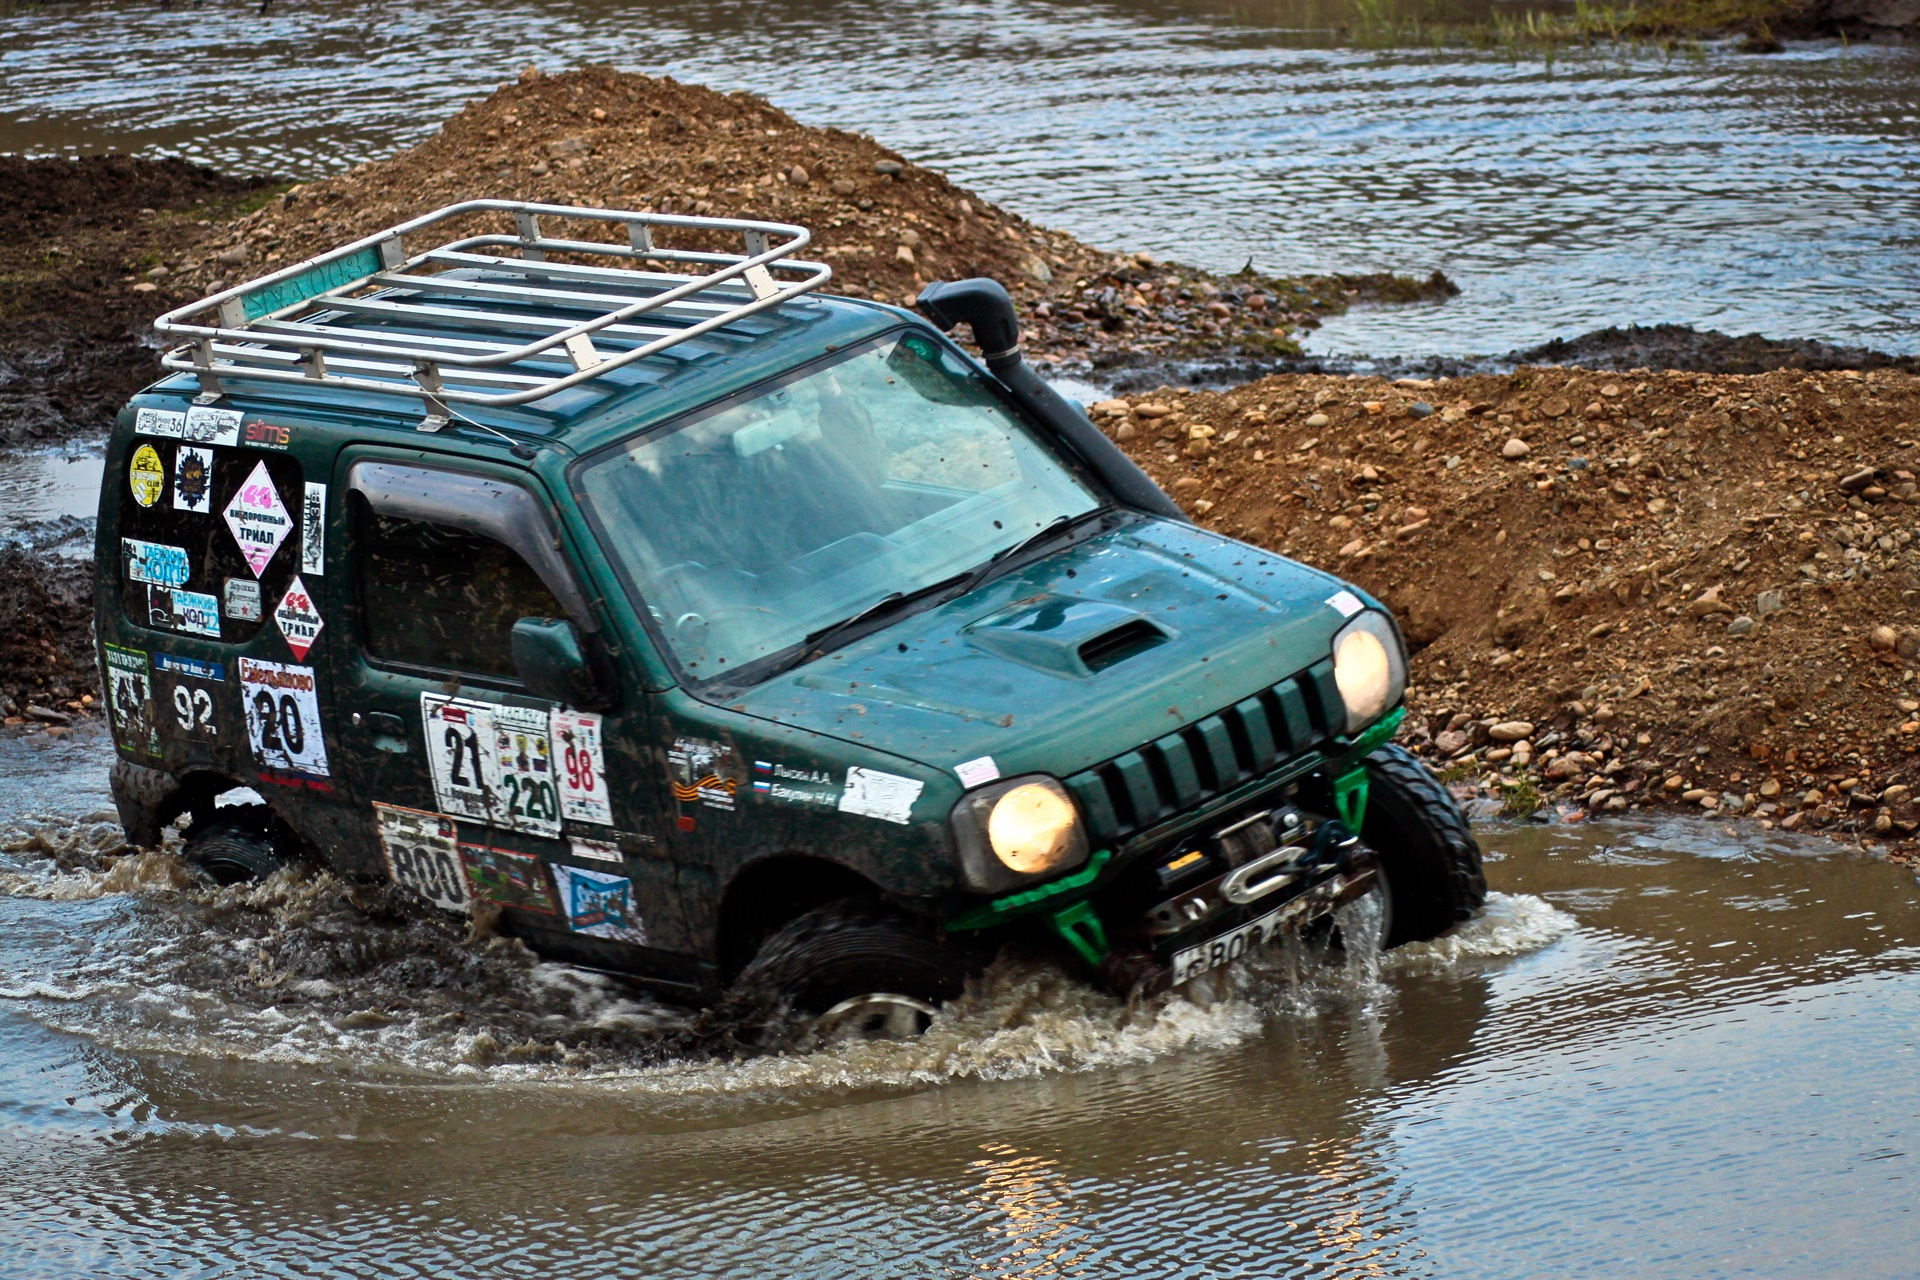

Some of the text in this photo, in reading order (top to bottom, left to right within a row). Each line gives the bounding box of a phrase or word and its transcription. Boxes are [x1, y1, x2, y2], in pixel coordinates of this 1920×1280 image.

[170, 418, 182, 433] 36
[239, 527, 275, 545] ТРИАЛ
[281, 621, 316, 638] ТРИАЛ
[173, 685, 217, 735] 92
[253, 690, 304, 755] 20
[445, 727, 484, 790] 21
[565, 747, 595, 793] 98
[504, 774, 558, 823] 220
